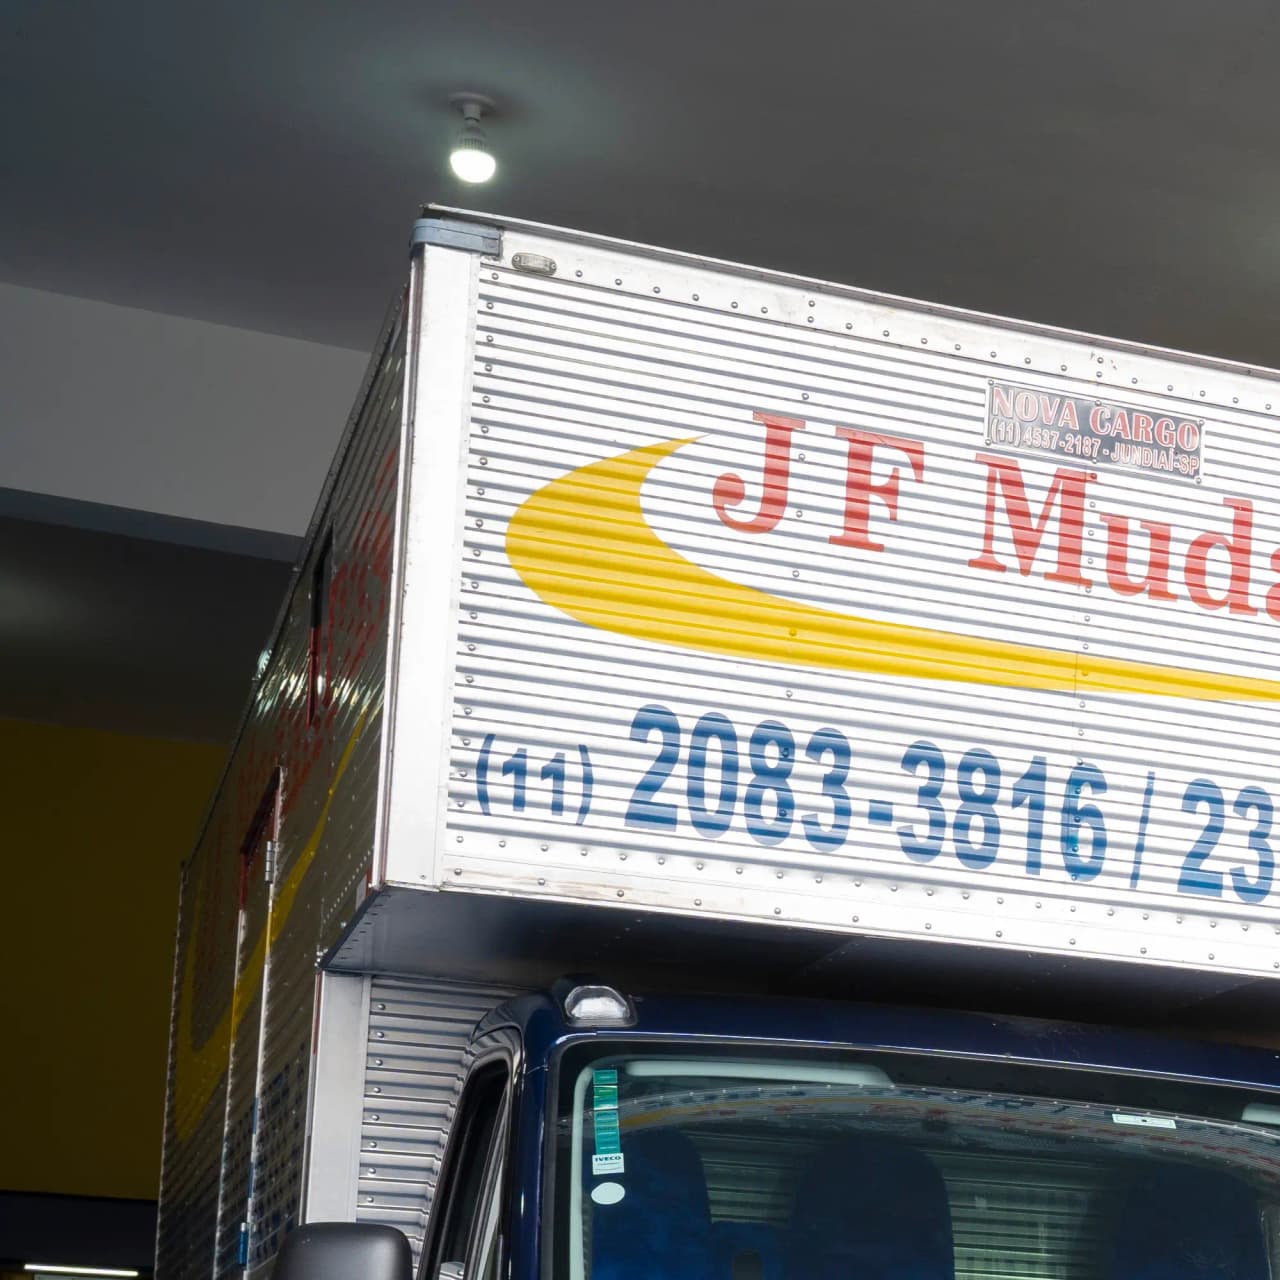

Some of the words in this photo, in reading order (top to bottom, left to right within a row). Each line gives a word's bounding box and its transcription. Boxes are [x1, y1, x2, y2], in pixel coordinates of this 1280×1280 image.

[991, 387, 1080, 430] NOVA
[1089, 405, 1200, 452] CARGO
[991, 419, 1021, 447] (11)
[475, 732, 594, 826] (11)
[625, 703, 1109, 882] 2083-3816
